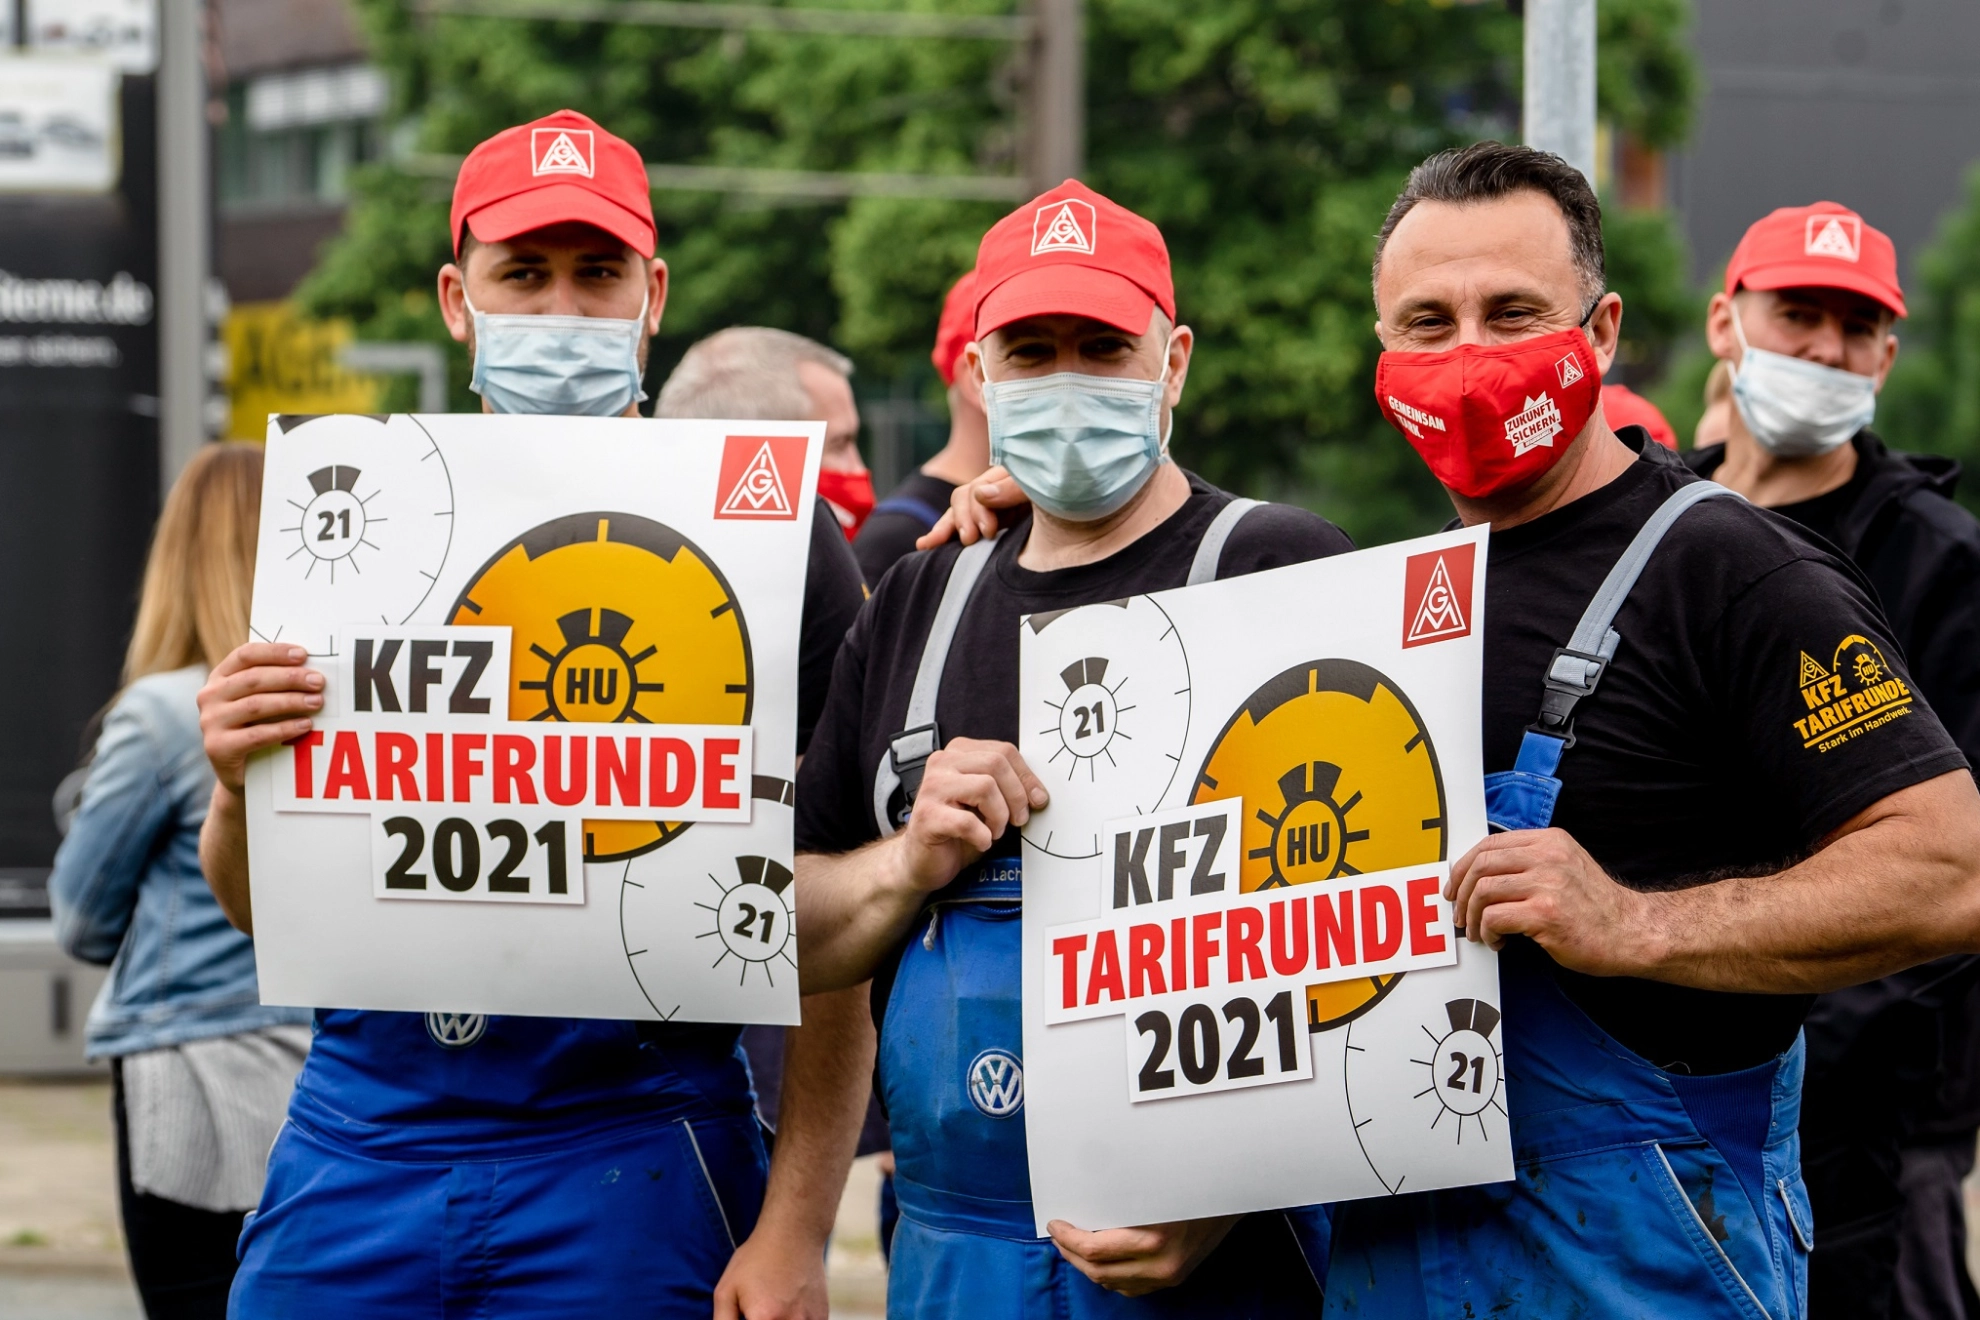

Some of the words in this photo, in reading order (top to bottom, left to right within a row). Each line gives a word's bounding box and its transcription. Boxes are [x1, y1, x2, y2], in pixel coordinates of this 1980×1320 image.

[1388, 395, 1446, 432] GEMEINSAM
[1507, 401, 1552, 432] ZUKUNFT
[1512, 413, 1560, 444] SICHERN.
[317, 508, 350, 542] 21
[353, 638, 494, 714] KFZ
[565, 667, 618, 705] HU
[1862, 664, 1875, 676] HU
[1793, 677, 1910, 740] TARIFRUNDE
[1801, 674, 1848, 710] KFZ
[1073, 700, 1104, 740] 21
[1818, 734, 1848, 753] Stark
[1848, 726, 1864, 739] im
[1864, 706, 1912, 732] Handwerk.
[284, 730, 741, 809] TARIFRUNDE
[382, 816, 568, 894] 2021
[1113, 813, 1228, 909] KFZ
[1287, 821, 1330, 867] HU
[733, 902, 775, 944] 21
[1053, 876, 1446, 1009] TARIFRUNDE
[1134, 991, 1298, 1092] 2021
[1447, 1051, 1485, 1094] 21
